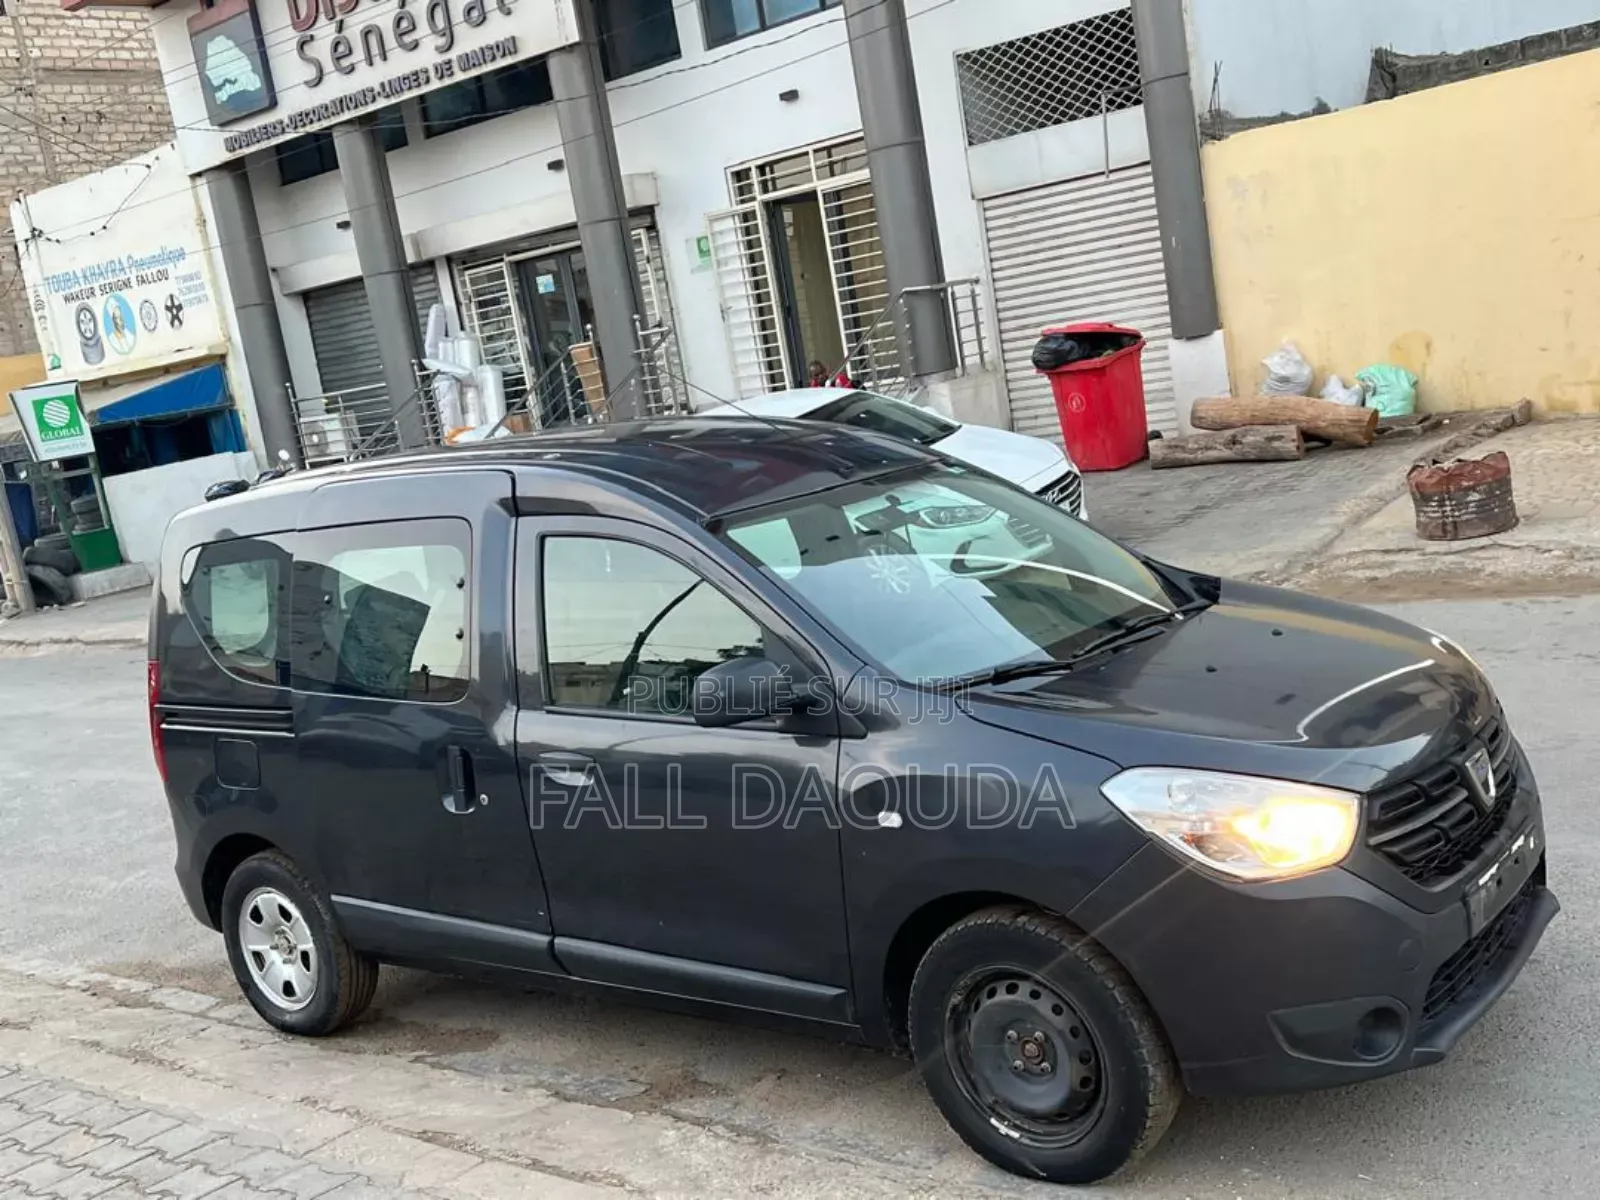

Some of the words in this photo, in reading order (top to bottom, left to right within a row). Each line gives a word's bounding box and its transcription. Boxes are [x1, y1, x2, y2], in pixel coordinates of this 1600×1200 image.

[433, 59, 454, 80] DE
[456, 35, 518, 72] MAISON
[45, 270, 81, 294] TOUBA
[62, 286, 97, 304] WAKEUR
[98, 277, 133, 297] SERIGNE
[135, 268, 170, 287] FALLOU
[41, 426, 83, 440] GLOBAL
